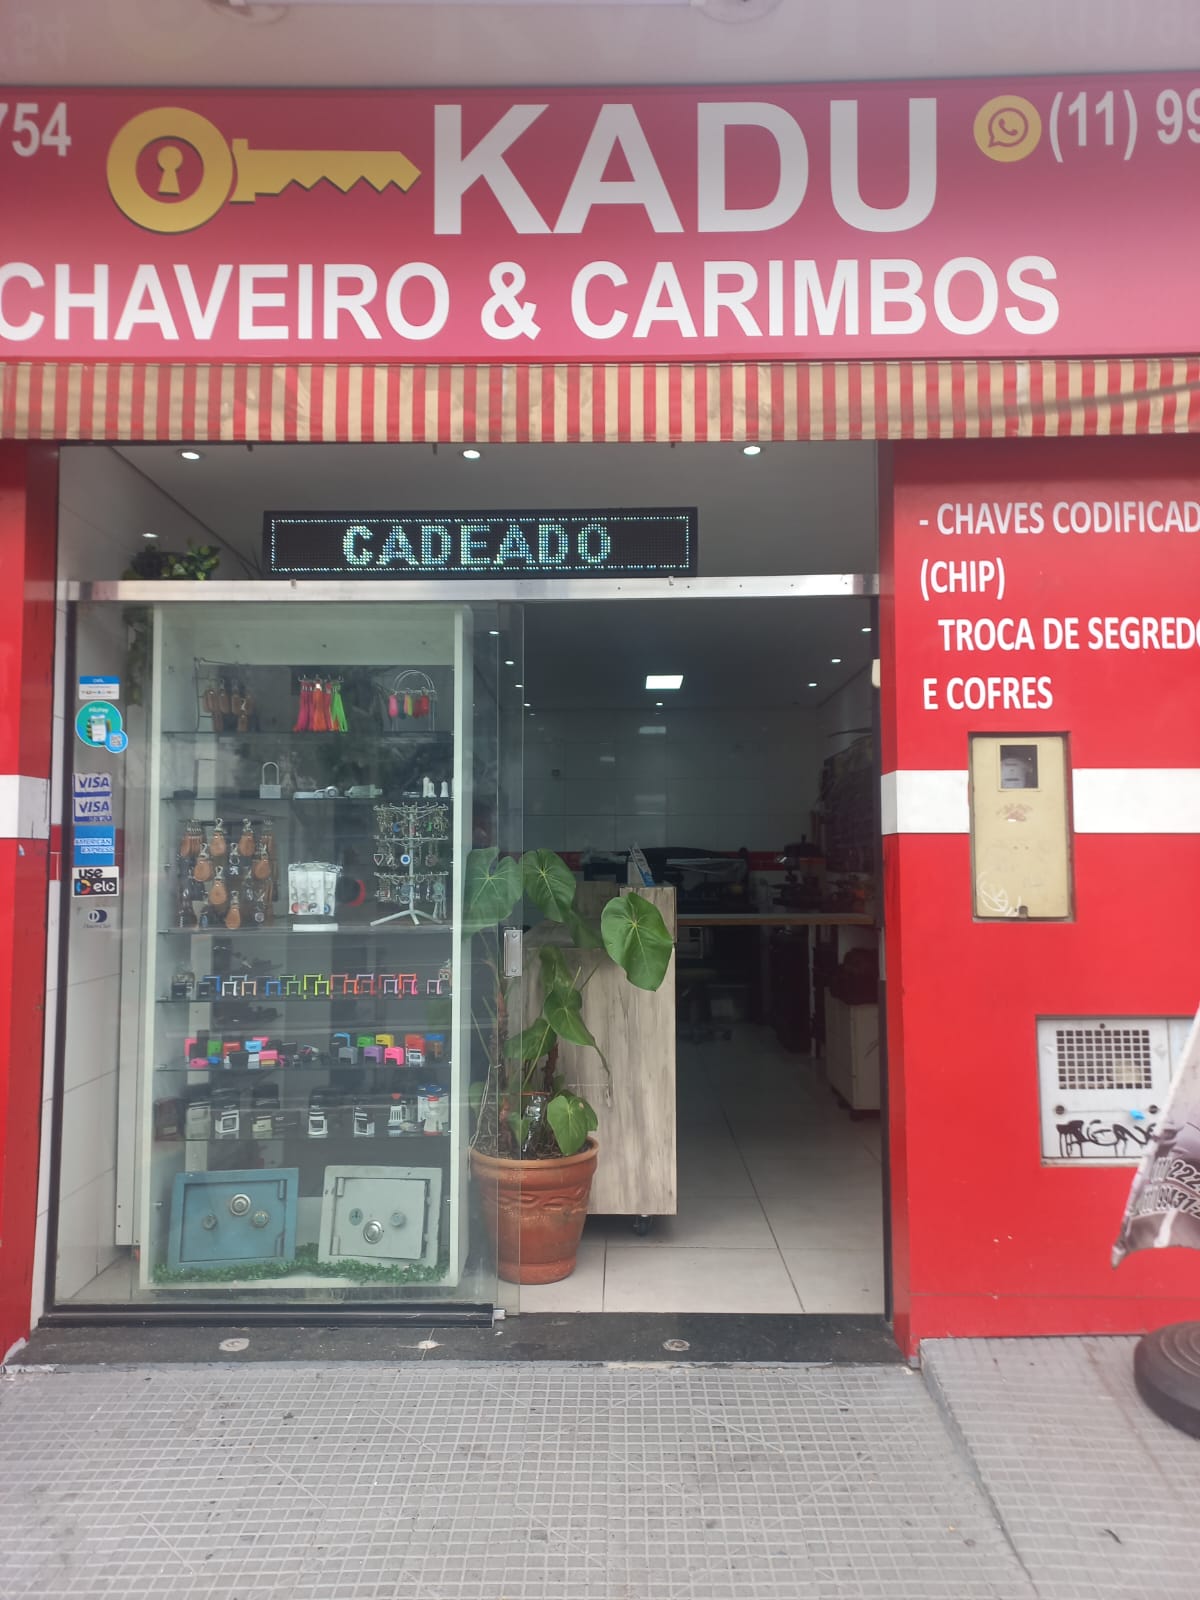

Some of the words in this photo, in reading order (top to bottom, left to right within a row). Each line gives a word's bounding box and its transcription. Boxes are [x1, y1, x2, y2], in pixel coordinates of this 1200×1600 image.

[1048, 89, 1138, 162] (11)
[433, 97, 938, 235] KADU
[0, 261, 450, 341] CHAVEIRO
[481, 261, 541, 341] &
[571, 255, 1059, 341] CARIMBOS
[937, 502, 1044, 535] CHAVES
[1052, 500, 1200, 534] CODIFICAD
[342, 523, 612, 566] CADEADO
[920, 557, 1006, 601] (CHIP)
[937, 618, 1036, 651] TROCA
[1043, 617, 1080, 650] DE
[1087, 616, 1200, 650] SEGRED
[923, 677, 939, 710] E
[946, 676, 1053, 710] COFRES
[79, 777, 110, 788] VISA
[79, 801, 110, 813] VISA
[78, 868, 104, 879] use
